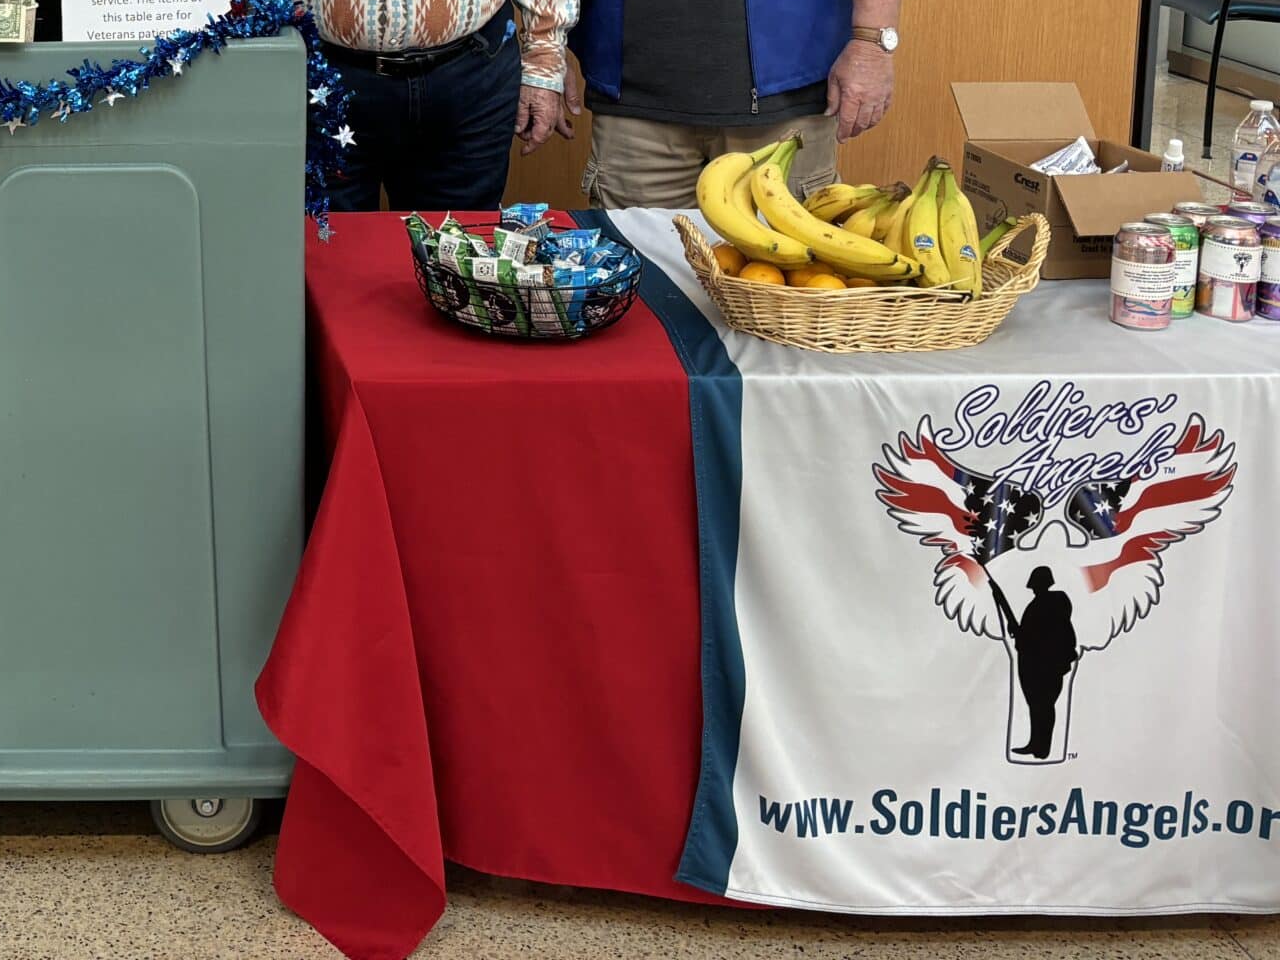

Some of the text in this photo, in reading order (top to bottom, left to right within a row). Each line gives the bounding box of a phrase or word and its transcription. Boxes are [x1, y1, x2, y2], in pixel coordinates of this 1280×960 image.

[103, 10, 192, 23] this table are for
[87, 28, 135, 40] Veterans
[1013, 172, 1041, 191] Crest
[934, 379, 1178, 452] Soldiers'
[986, 424, 1178, 509] Angels
[1067, 752, 1078, 760] TM
